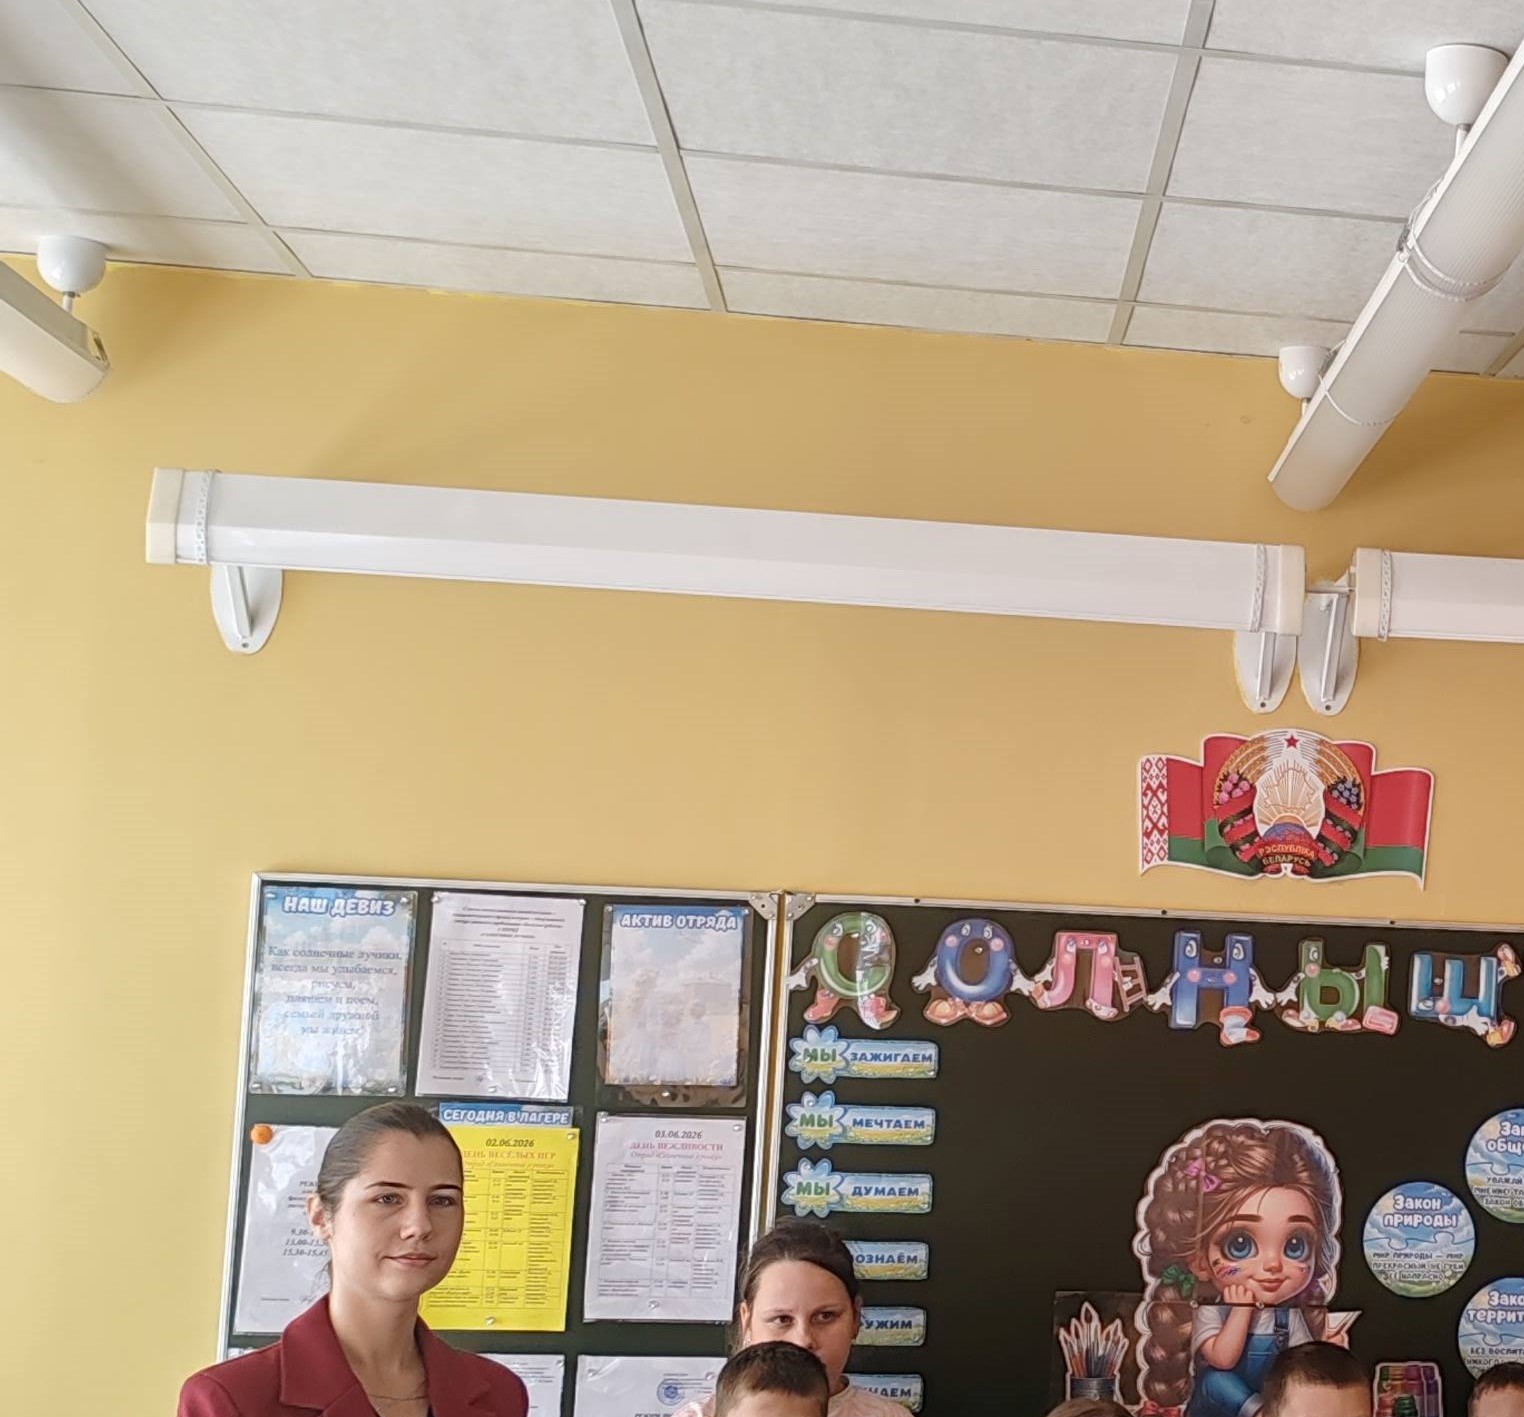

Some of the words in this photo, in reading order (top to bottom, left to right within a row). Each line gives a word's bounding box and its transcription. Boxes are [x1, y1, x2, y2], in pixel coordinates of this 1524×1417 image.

[283, 897, 328, 914] НАШ
[330, 898, 396, 917] ДЕВИЗ
[620, 913, 674, 929] АКТИВ
[676, 914, 738, 932] ОТРЯДА
[803, 1048, 837, 1063] МЫ
[850, 1052, 933, 1064] ЗАЖИГАЕМ
[443, 1108, 506, 1123] СЕГОДНЯ
[508, 1113, 518, 1123] В
[519, 1112, 569, 1124] ЛАГЕРЕ
[800, 1113, 834, 1128] МЫ
[852, 1117, 926, 1129] МЕЧТАЕМ
[485, 1138, 535, 1147] 02.06.2026
[796, 1182, 830, 1197] МЫ
[851, 1186, 919, 1198] ДУМАЕМ
[1393, 1194, 1442, 1211] Закон
[1383, 1212, 1458, 1228] природы
[851, 1252, 918, 1264] ОЗНАЁМ
[860, 1320, 912, 1330] УЖИМ
